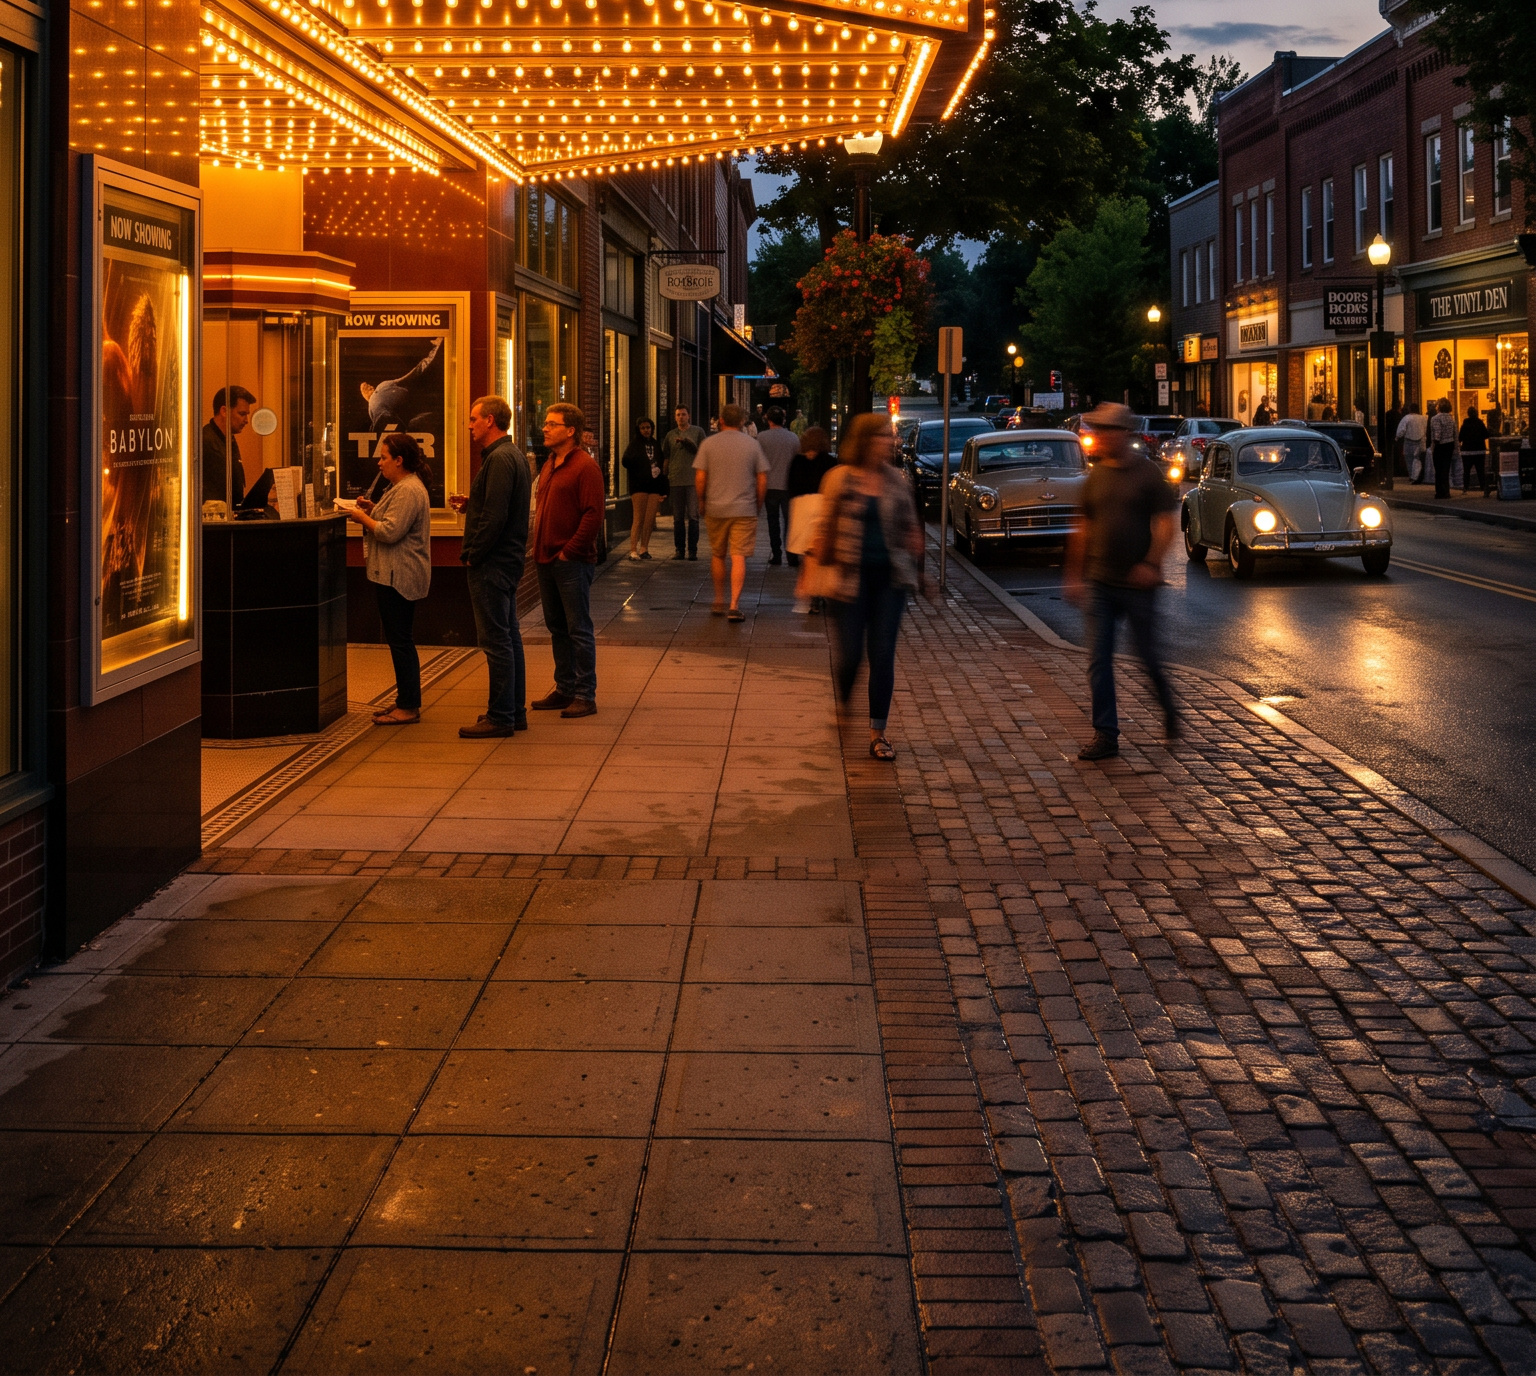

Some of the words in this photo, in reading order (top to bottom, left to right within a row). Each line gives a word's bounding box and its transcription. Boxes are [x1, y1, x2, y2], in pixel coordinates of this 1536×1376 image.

[110, 215, 132, 240] NOW
[134, 222, 172, 251] SHOWING
[1430, 295, 1452, 318] THE
[1453, 291, 1483, 315] VINYL
[1485, 287, 1508, 311] DEN
[379, 314, 441, 326] SHOWING
[110, 427, 173, 454] BABYLON
